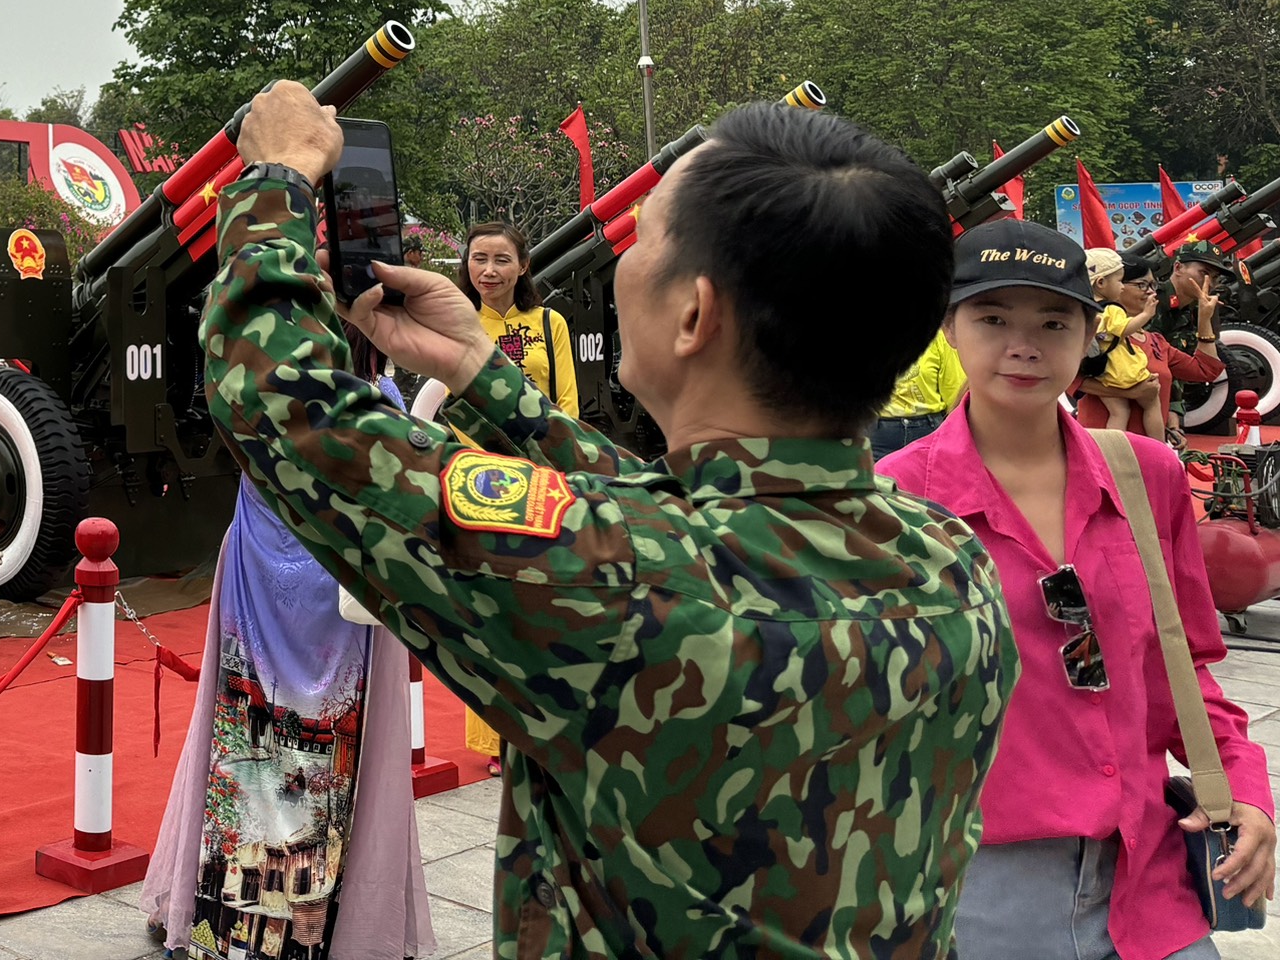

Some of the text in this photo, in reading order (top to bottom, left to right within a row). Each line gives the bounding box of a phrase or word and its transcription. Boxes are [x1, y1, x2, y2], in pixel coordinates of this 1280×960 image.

[1194, 183, 1219, 191] OCOP
[1118, 201, 1140, 210] OCOP
[980, 247, 1066, 269] The Weird
[579, 332, 604, 362] 002
[126, 344, 162, 380] 001
